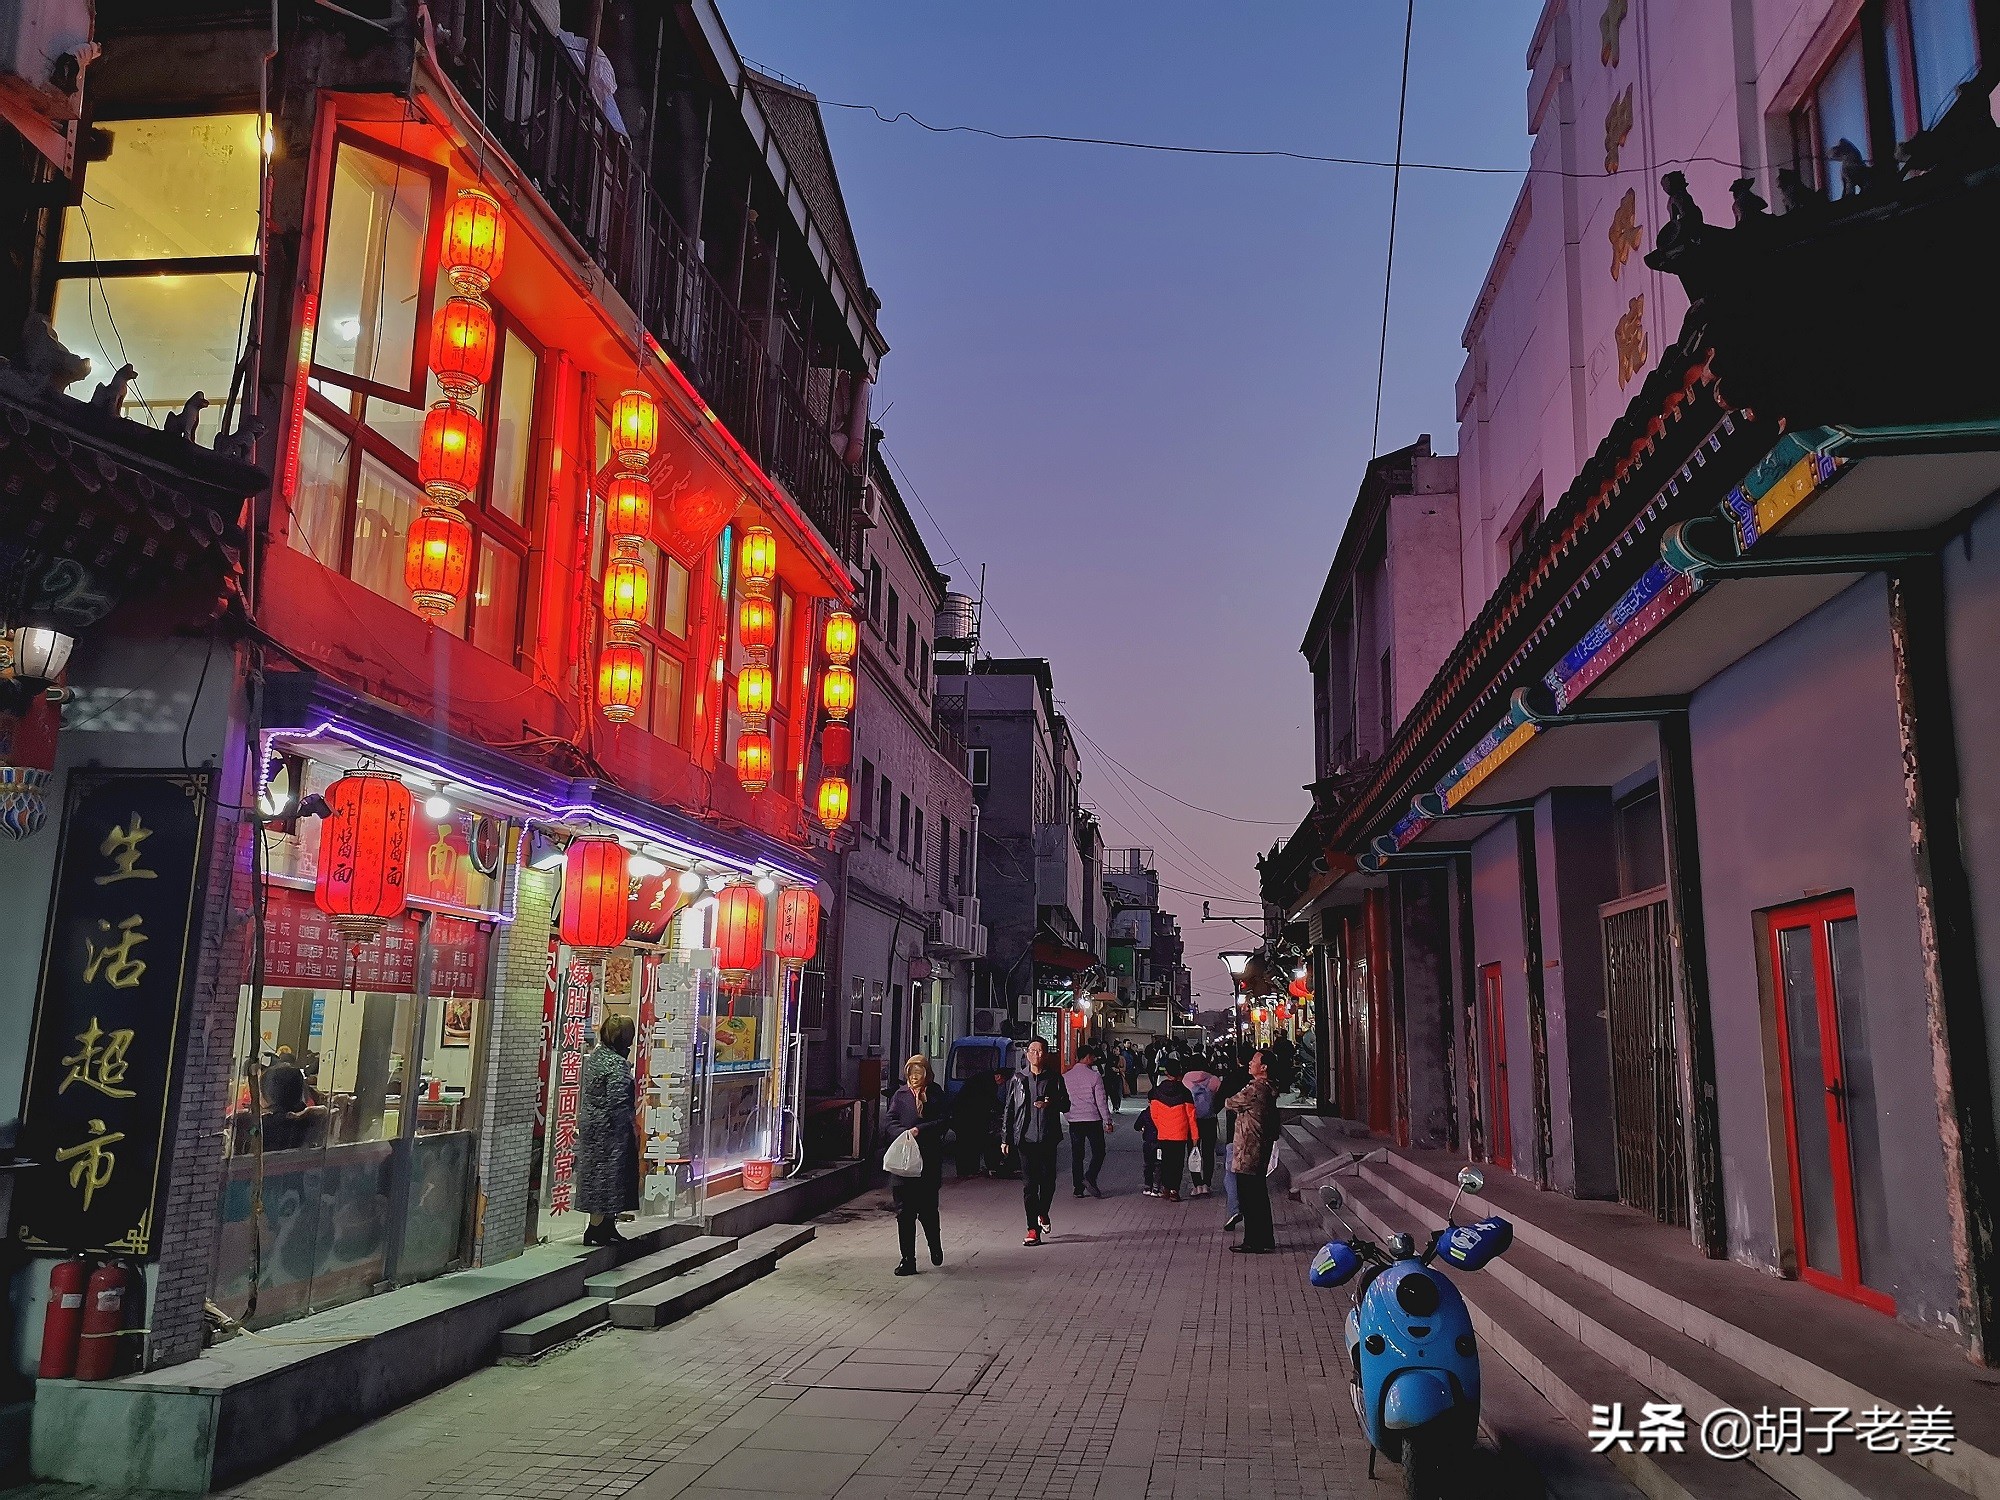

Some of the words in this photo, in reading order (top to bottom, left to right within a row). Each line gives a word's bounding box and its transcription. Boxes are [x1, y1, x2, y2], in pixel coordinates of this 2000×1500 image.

[428, 824, 458, 889] 面
[55, 811, 158, 1212] 生活超市
[549, 954, 590, 1218] 爆肚炸酱面家常菜
